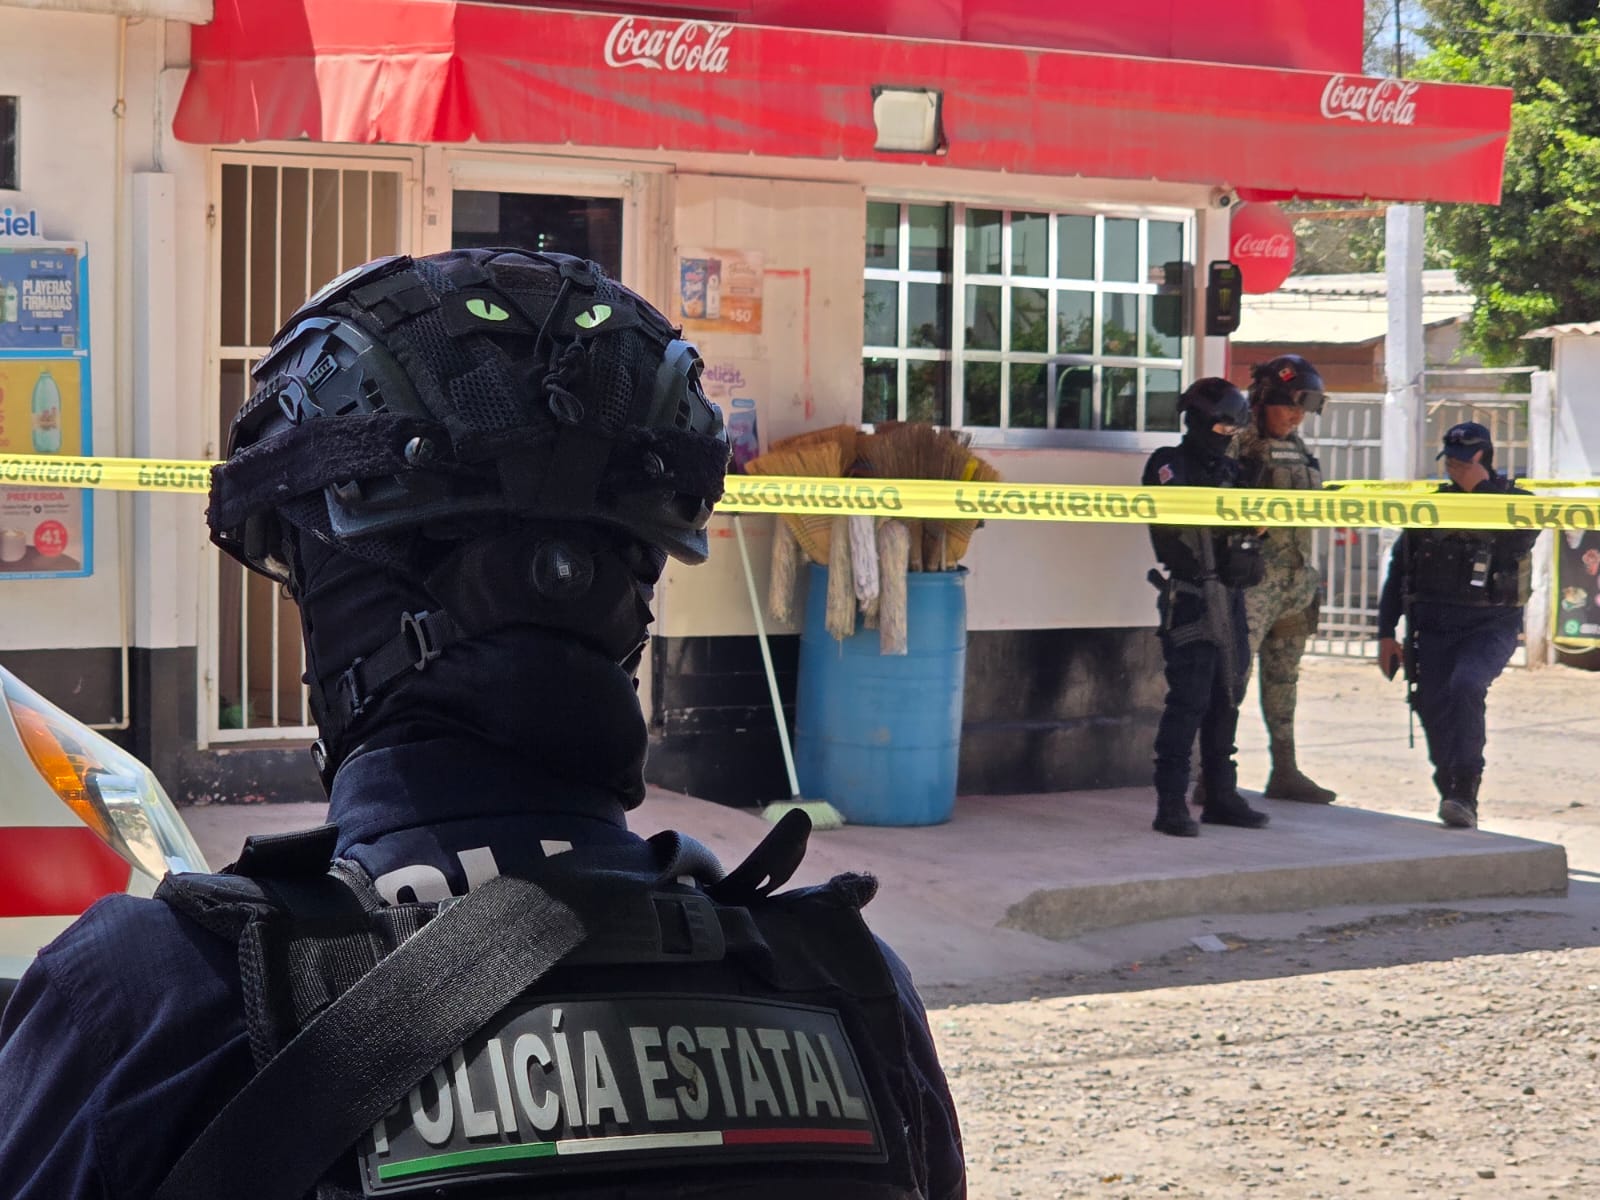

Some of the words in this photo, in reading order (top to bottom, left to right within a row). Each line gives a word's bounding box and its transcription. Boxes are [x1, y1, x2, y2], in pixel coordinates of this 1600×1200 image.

[604, 16, 734, 73] Coca-Cola
[1320, 74, 1419, 125] Coca-Cola
[1234, 233, 1290, 259] Coca-Cola
[22, 280, 72, 295] PLAYERAS
[22, 295, 73, 311] FIRMADAS
[6, 492, 65, 501] PREFERIDA
[40, 529, 62, 545] 41
[629, 1026, 868, 1121] ESTATAL
